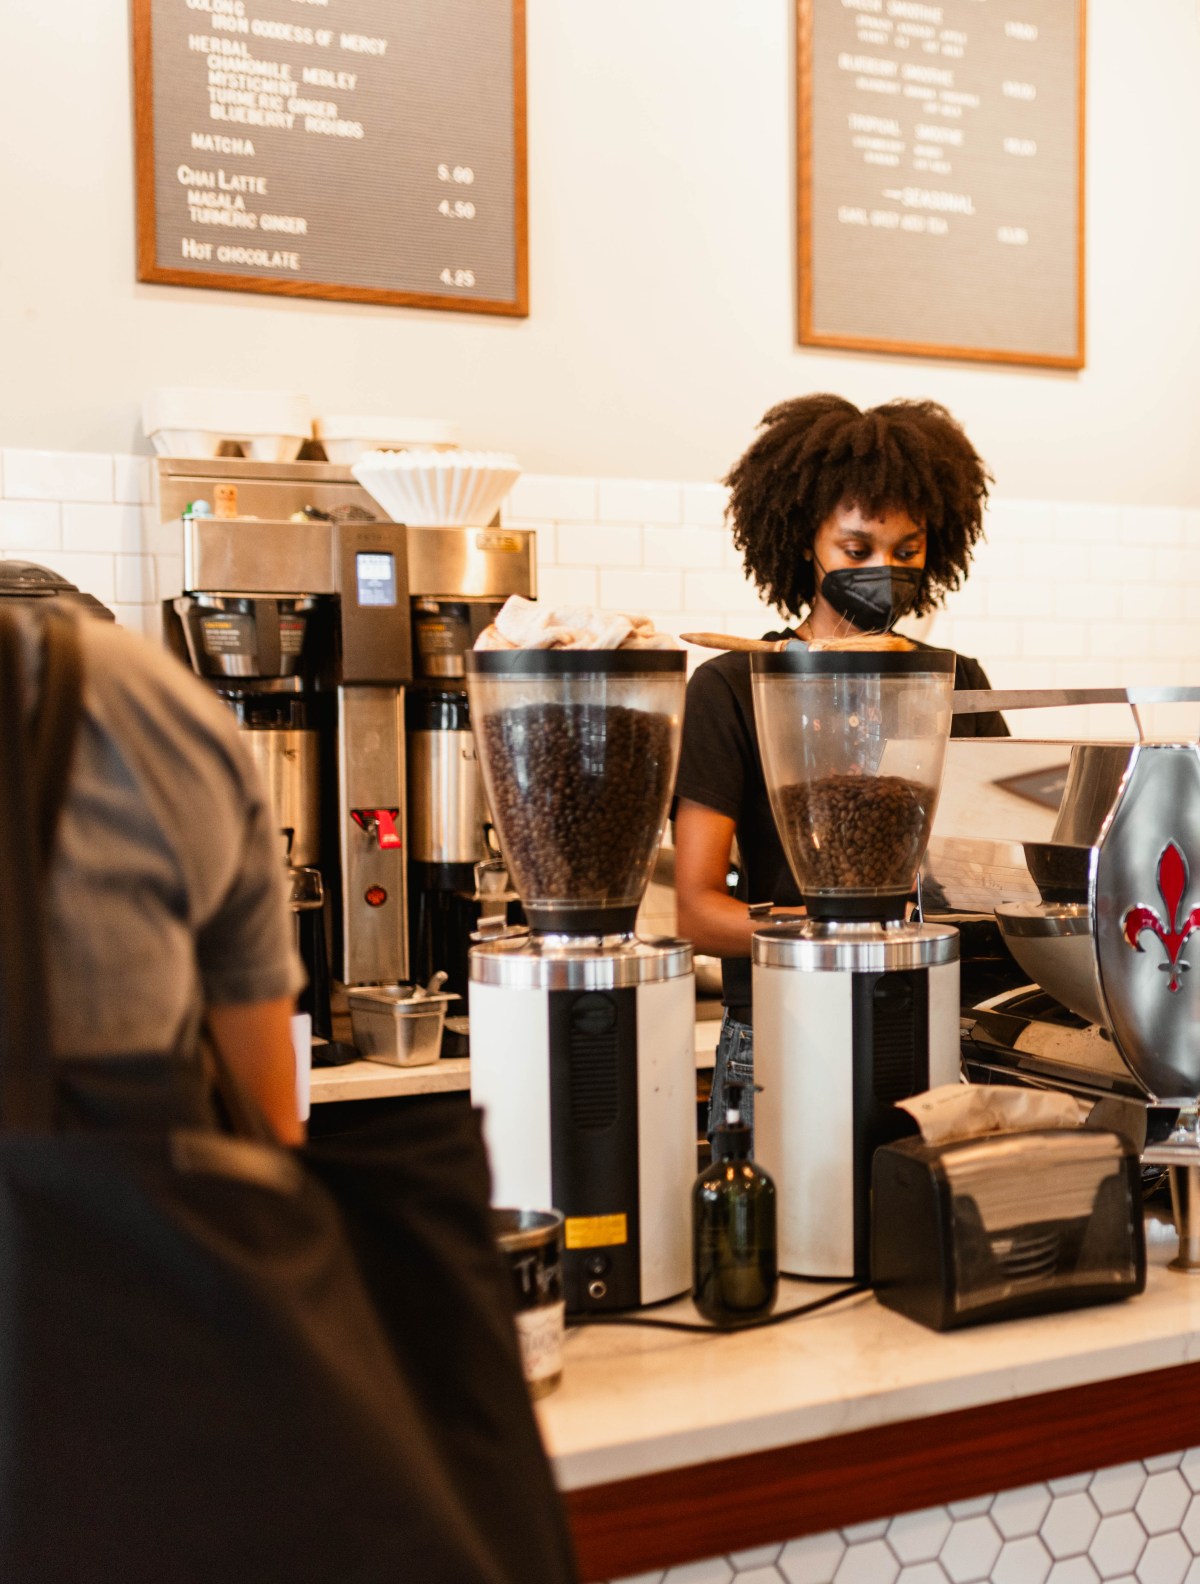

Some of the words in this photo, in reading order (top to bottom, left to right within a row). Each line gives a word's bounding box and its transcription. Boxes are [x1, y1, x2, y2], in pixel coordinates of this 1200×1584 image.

[188, 34, 251, 58] HERBAL
[211, 14, 249, 34] IRON
[315, 29, 334, 47] OF
[340, 32, 388, 56] MERCY
[207, 54, 292, 81] CHAMOMILE
[302, 66, 357, 90] MEDLEY
[209, 103, 295, 129] BLUEBERRY
[190, 132, 255, 156] MATCHA
[187, 189, 246, 211] MASALA
[438, 199, 476, 220] 4.50
[188, 205, 257, 230] TURMERIC
[259, 213, 308, 235] GINGER
